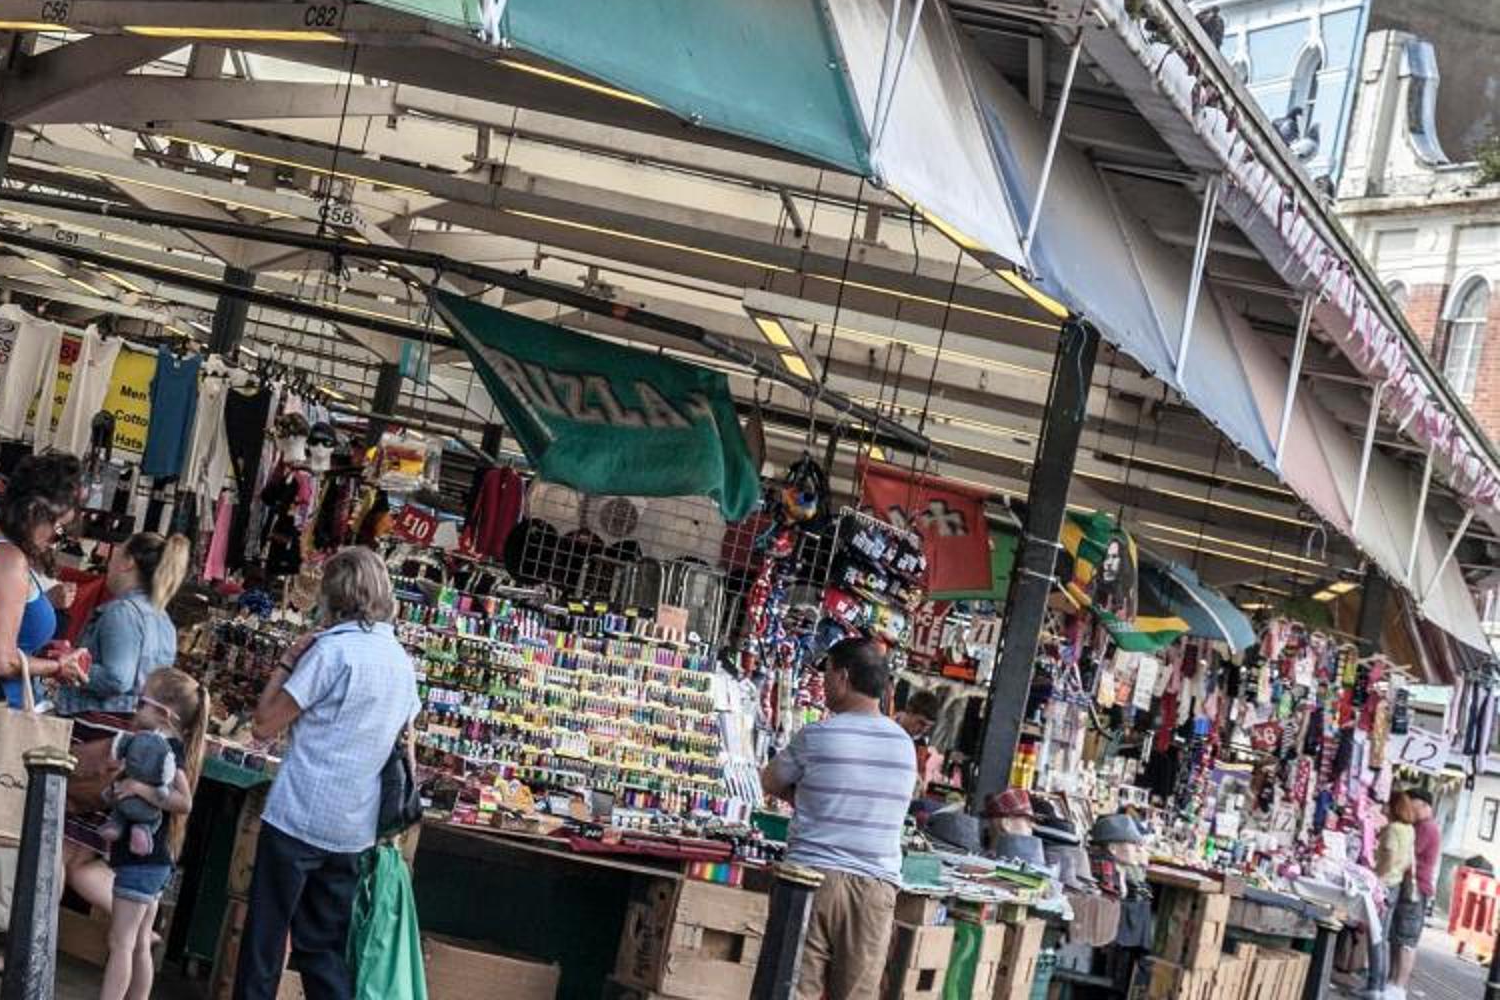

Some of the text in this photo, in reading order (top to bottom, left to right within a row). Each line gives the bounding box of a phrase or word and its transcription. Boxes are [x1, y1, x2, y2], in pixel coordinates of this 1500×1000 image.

[304, 5, 337, 27] C82
[318, 204, 353, 226] C58
[55, 230, 79, 245] C51
[120, 384, 148, 401] Men
[114, 409, 148, 427] Cotto
[404, 513, 430, 539] £10
